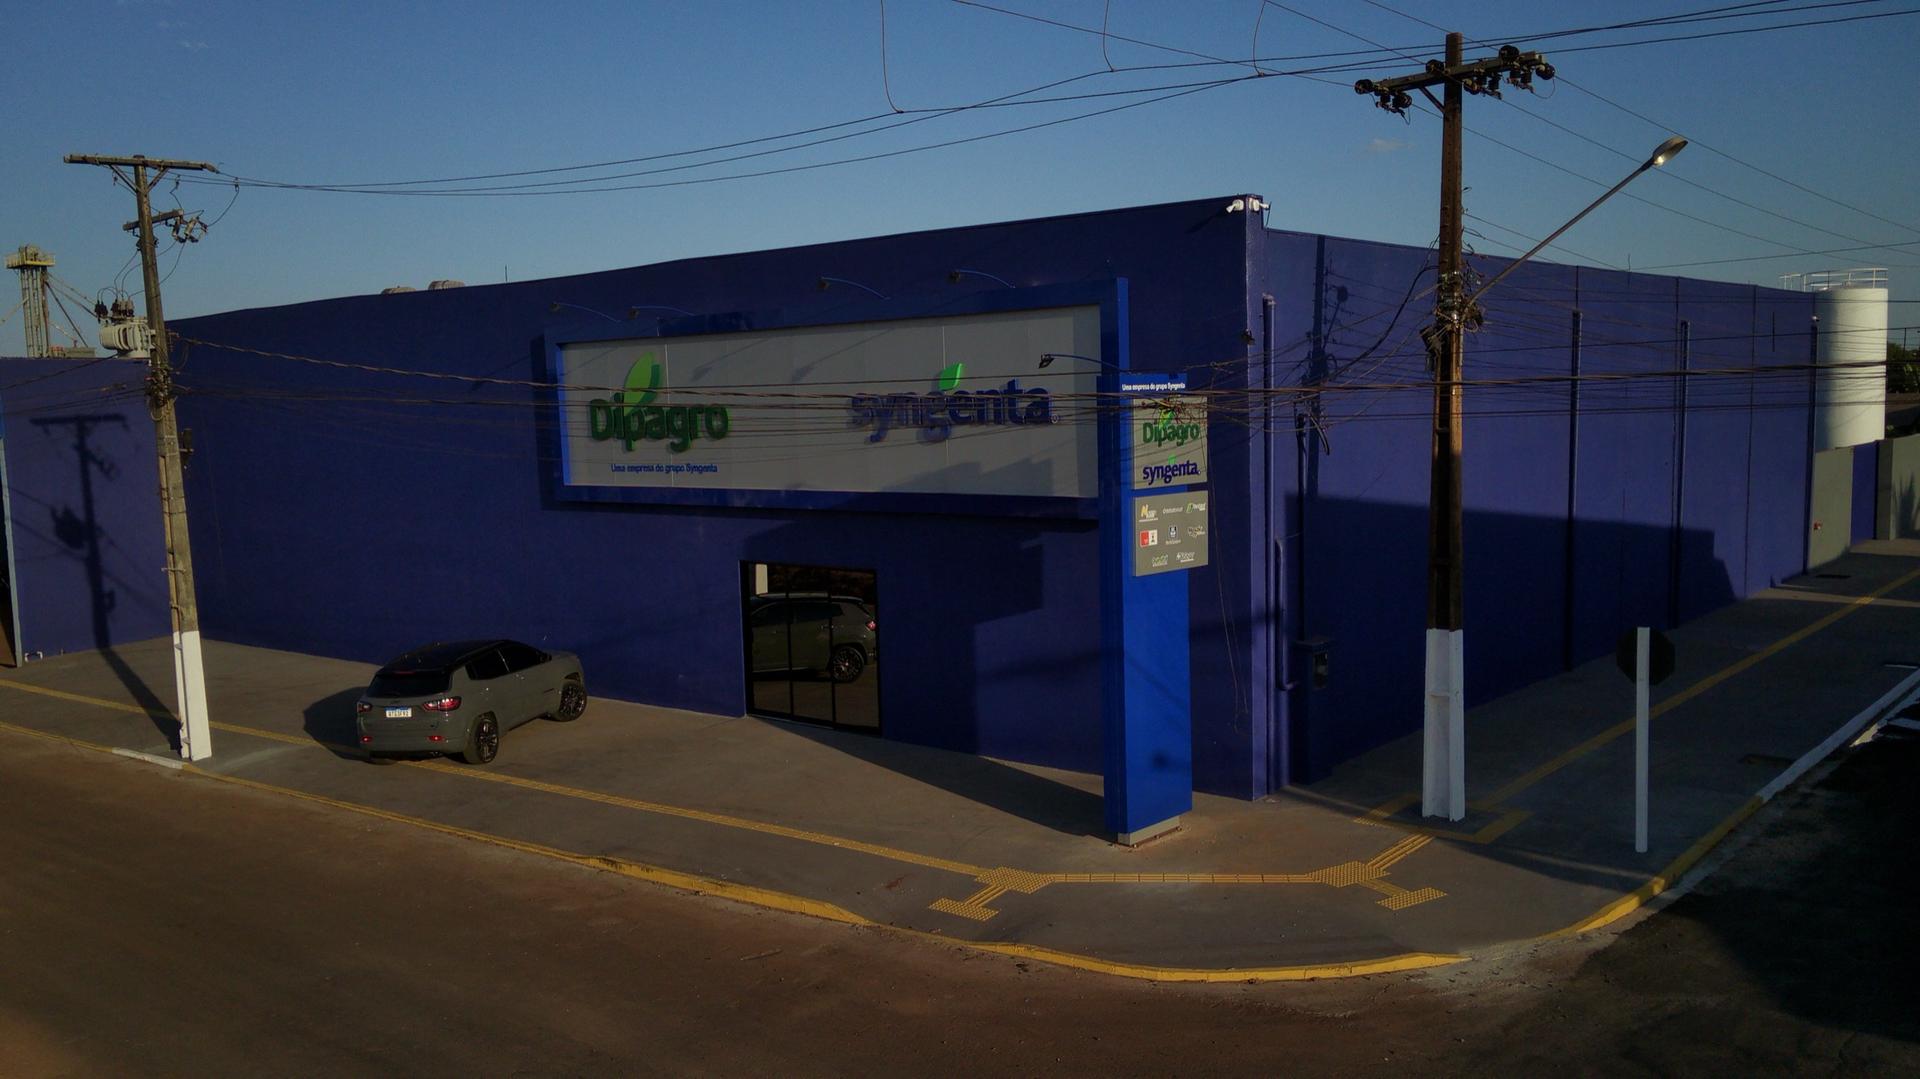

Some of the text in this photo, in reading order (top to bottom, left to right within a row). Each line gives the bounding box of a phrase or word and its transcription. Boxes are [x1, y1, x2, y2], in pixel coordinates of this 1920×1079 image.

[850, 379, 1050, 442] syngenta
[590, 395, 729, 452] Dipagro
[1143, 422, 1200, 447] Dipagro
[611, 463, 717, 473] Uma empresa do grupo Syngenta
[1143, 460, 1199, 485] syngenta
